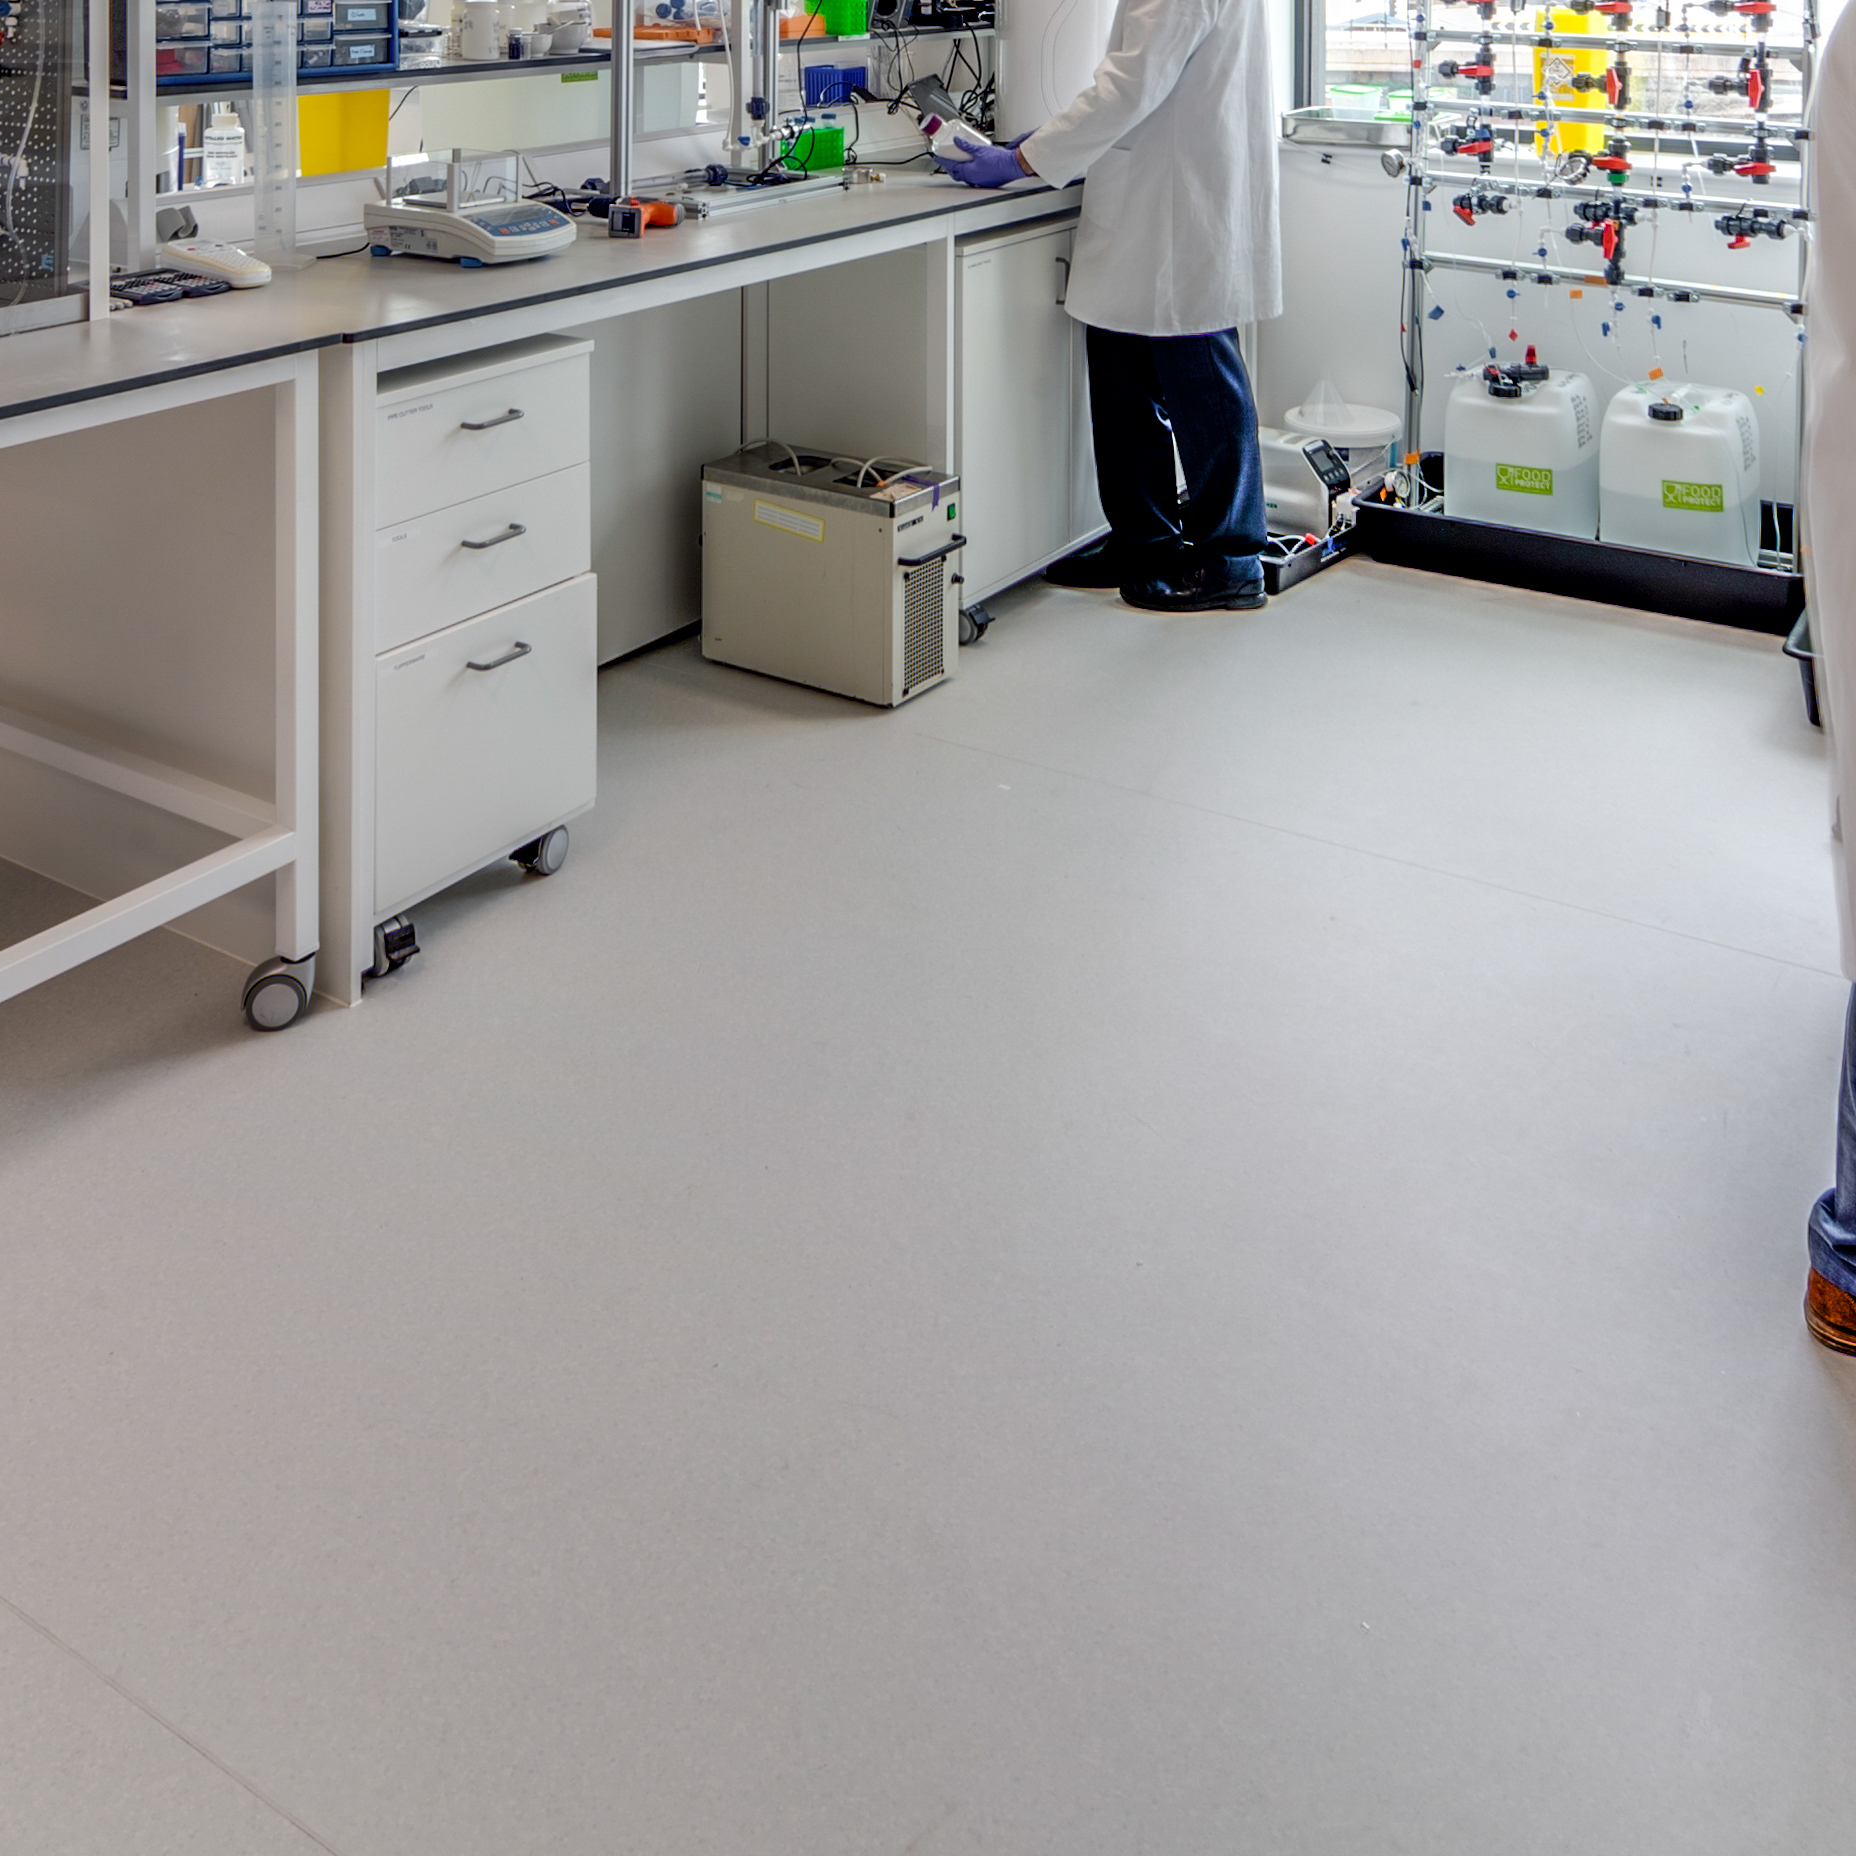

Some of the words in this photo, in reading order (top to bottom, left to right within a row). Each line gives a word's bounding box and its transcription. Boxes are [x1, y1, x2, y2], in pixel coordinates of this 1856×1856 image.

[1514, 468, 1551, 482] FOOD
[1514, 479, 1551, 490] PROTECT
[1682, 484, 1721, 498] FOOD
[1682, 496, 1721, 507] PROTECT
